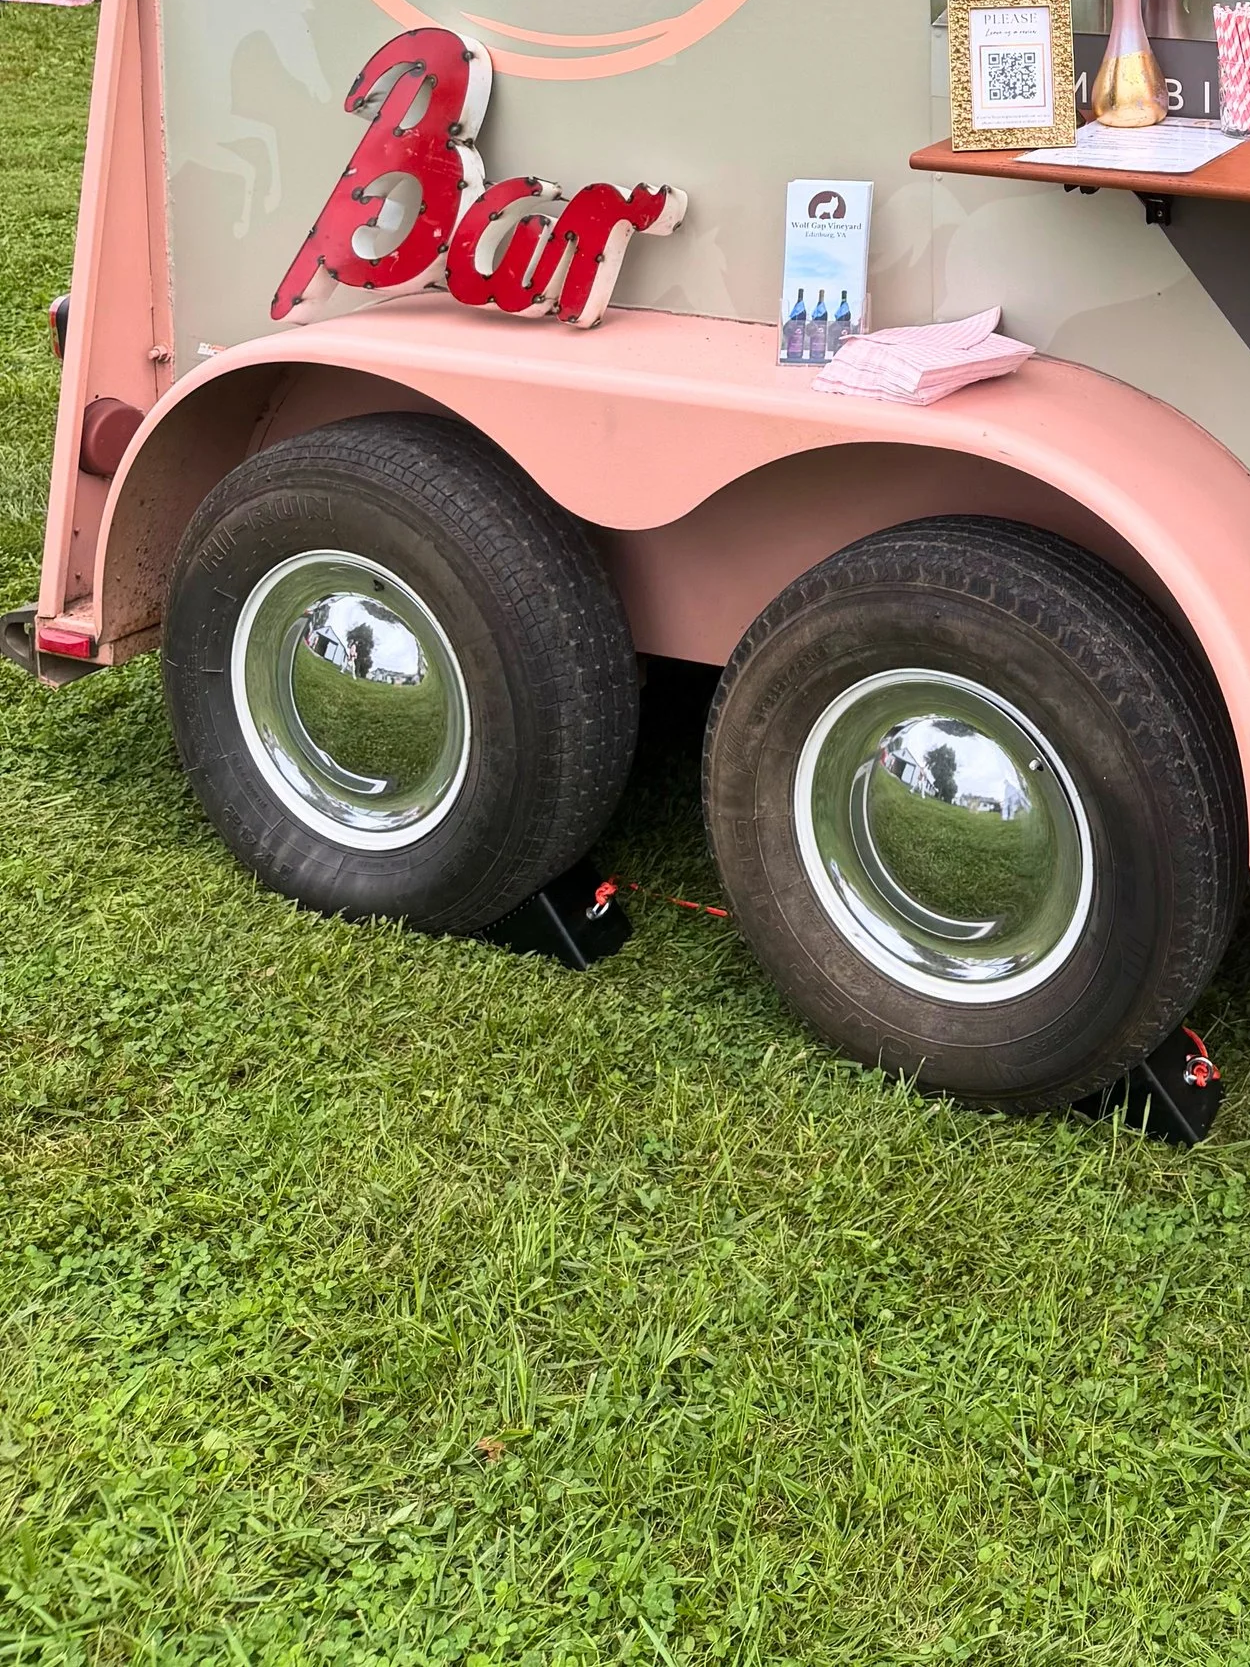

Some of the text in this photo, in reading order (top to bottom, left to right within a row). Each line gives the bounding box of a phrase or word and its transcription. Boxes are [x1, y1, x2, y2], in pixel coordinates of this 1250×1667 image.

[984, 12, 1038, 25] PLEASE
[270, 27, 689, 329] Bar
[792, 221, 861, 231] Wolf Gap Vineyard
